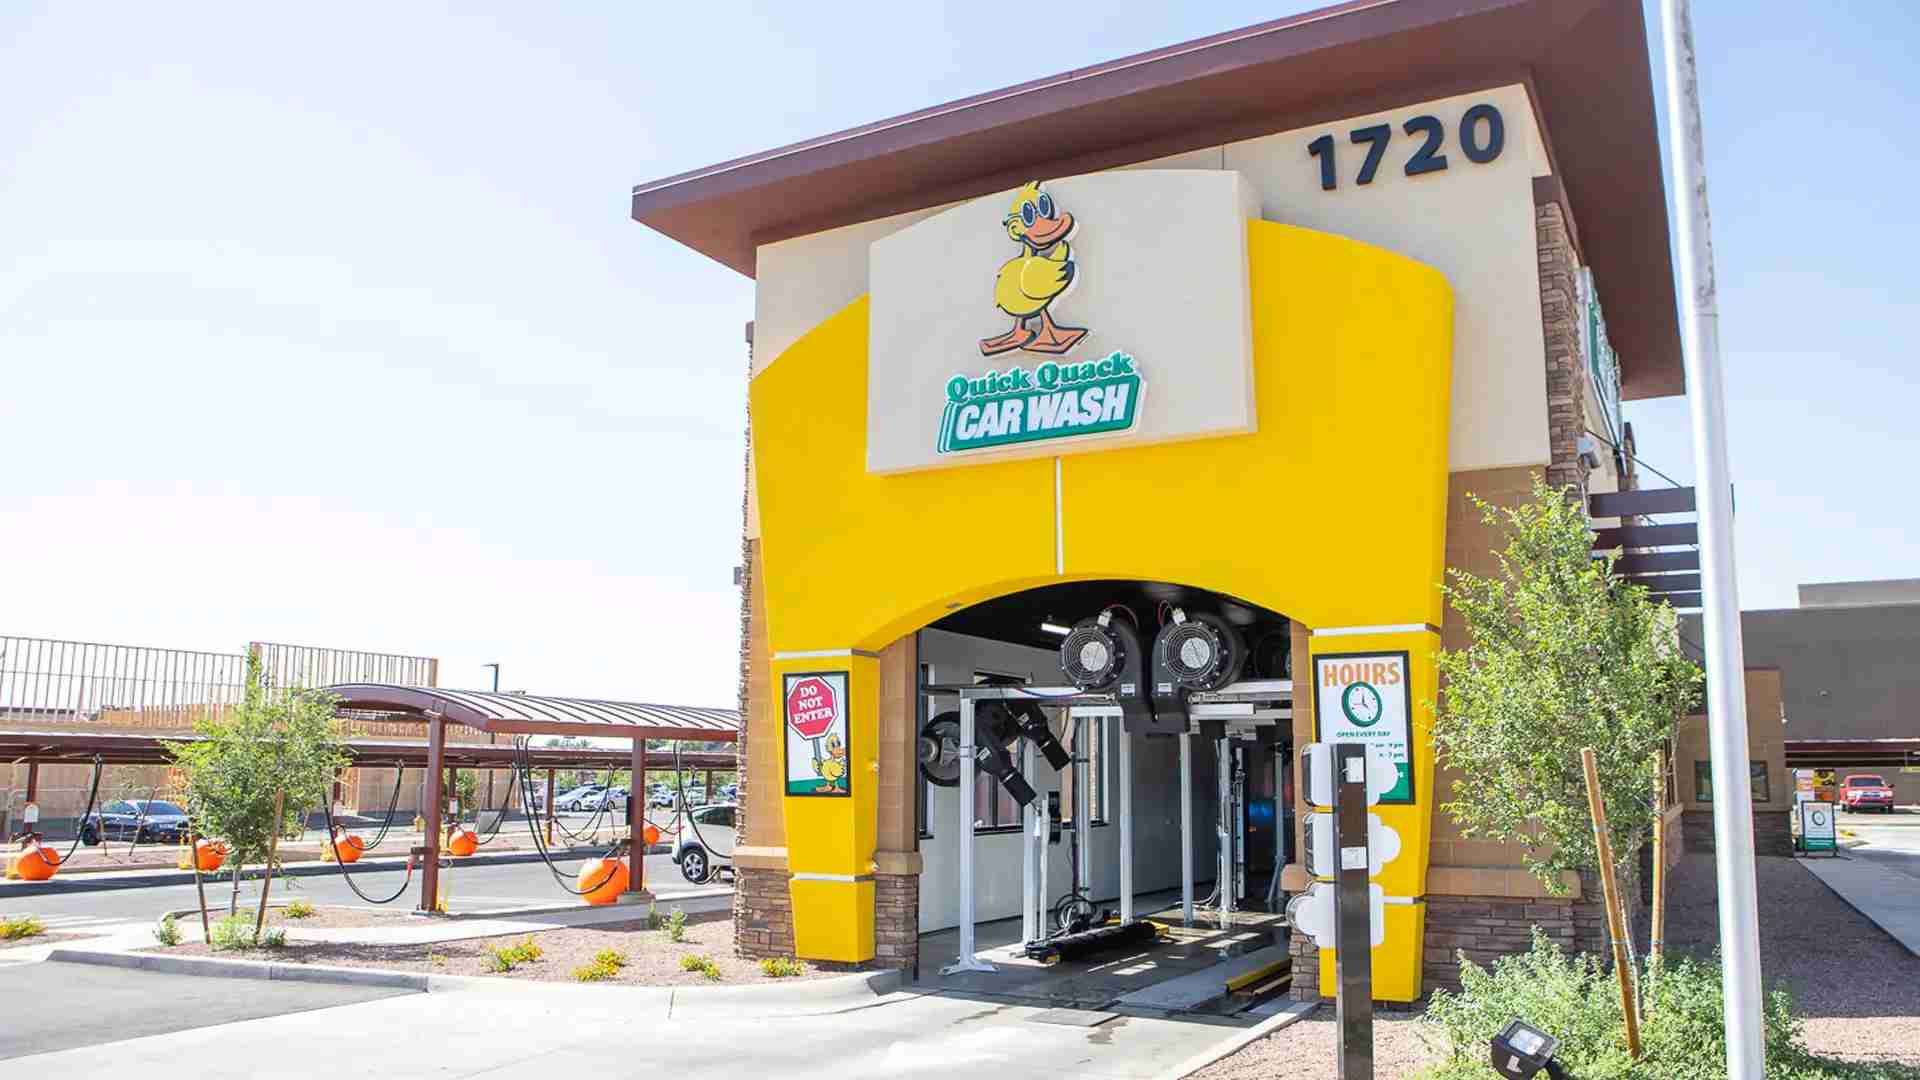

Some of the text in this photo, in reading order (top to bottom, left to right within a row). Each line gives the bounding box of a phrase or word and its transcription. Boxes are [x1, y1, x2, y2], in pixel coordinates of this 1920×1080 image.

[1308, 104, 1504, 190] 1720
[947, 352, 1134, 401] Quick Quack
[955, 383, 1130, 440] CAR WASH
[1323, 662, 1400, 687] HOURS
[798, 696, 823, 711] NOT
[800, 685, 817, 697] DO
[793, 707, 833, 724] ENTER
